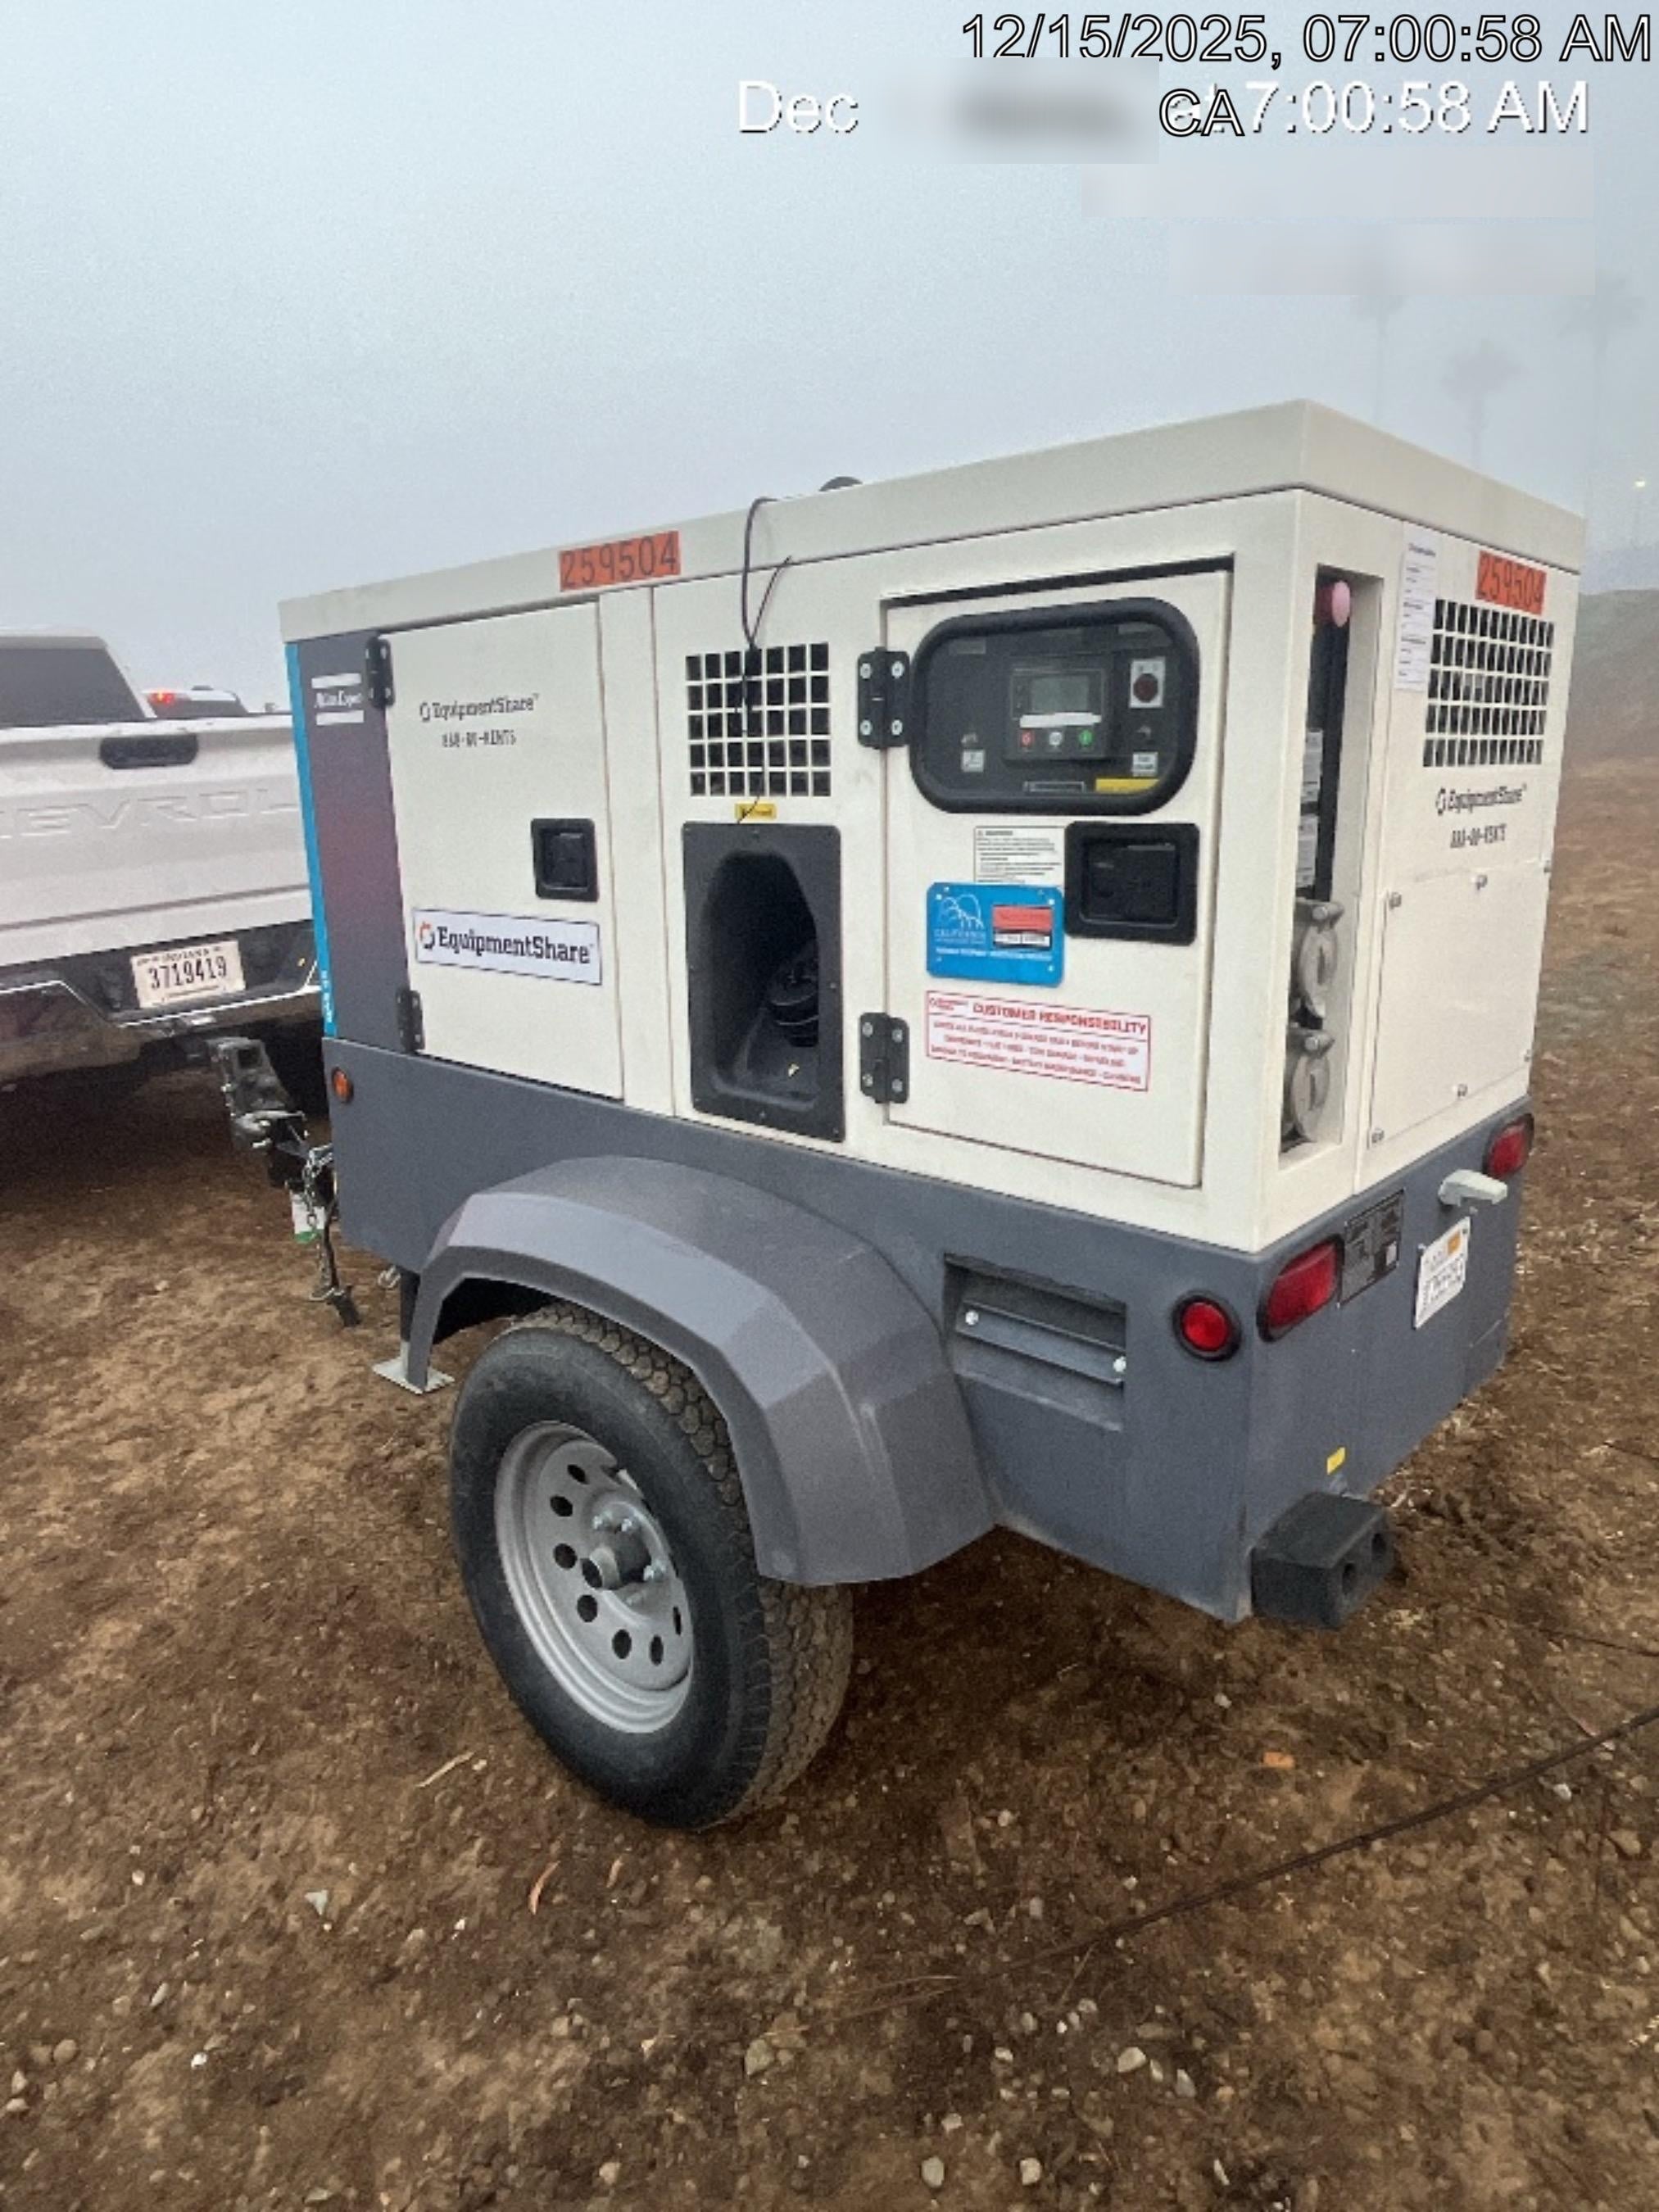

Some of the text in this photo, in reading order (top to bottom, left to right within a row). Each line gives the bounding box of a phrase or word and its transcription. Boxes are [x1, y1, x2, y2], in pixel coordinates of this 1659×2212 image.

[561, 534, 676, 587] 259504
[1477, 551, 1545, 614] 259504
[437, 927, 590, 964] EquipmentShare
[147, 955, 227, 990] 3719419
